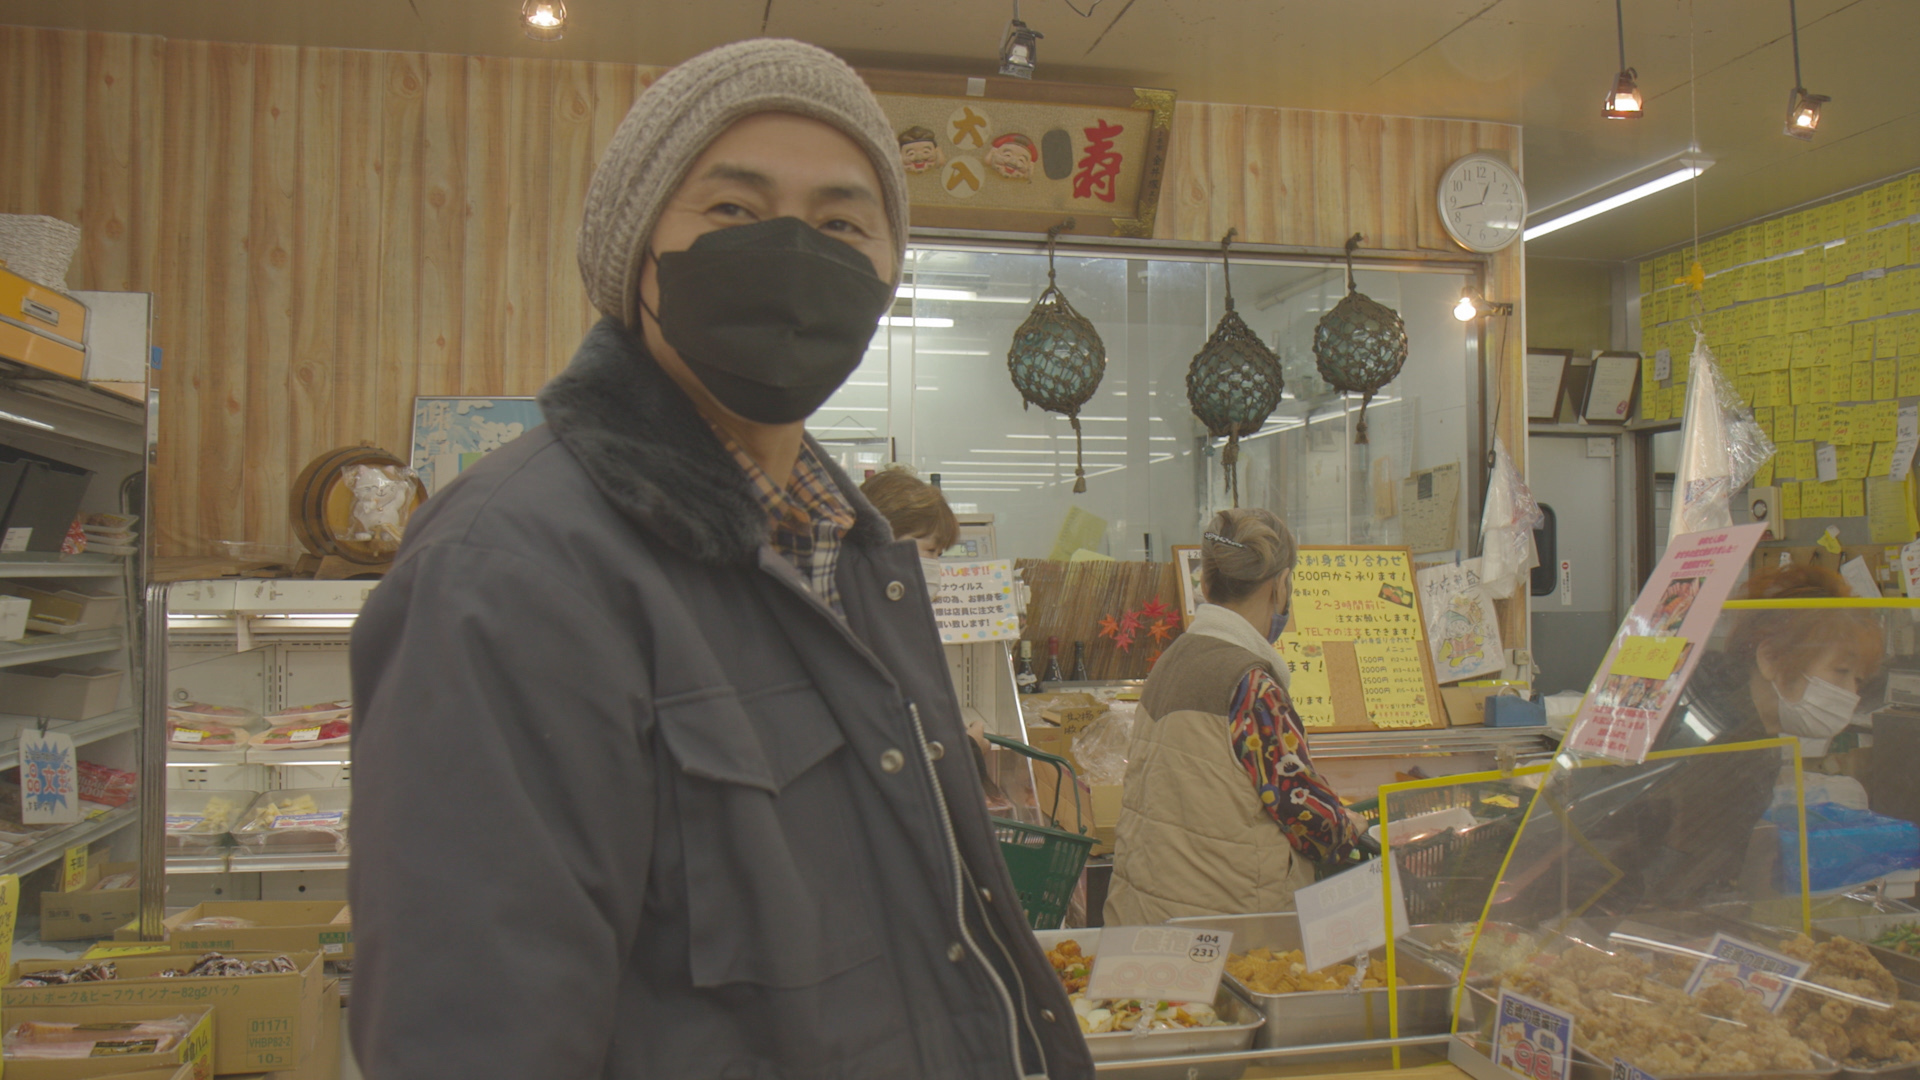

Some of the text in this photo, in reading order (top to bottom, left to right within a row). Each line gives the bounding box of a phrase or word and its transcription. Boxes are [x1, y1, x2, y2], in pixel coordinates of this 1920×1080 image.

[1073, 119, 1123, 203] 寿
[1463, 169, 1471, 181] 11
[1476, 166, 1486, 178] 12
[1493, 171, 1497, 182] 1
[1453, 180, 1463, 192] 10
[1502, 184, 1508, 195] 2
[1450, 196, 1457, 207] 9
[1506, 199, 1513, 211] 3
[1454, 212, 1461, 223] 8
[1466, 224, 1472, 236] 7
[1479, 229, 1486, 240] 6
[1363, 676, 1389, 684] 2500円
[1364, 686, 1391, 695] 3000円
[1195, 933, 1219, 944] 404
[1192, 947, 1215, 958] 231
[252, 1019, 288, 1033] 01171
[1514, 1039, 1553, 1080] 98
